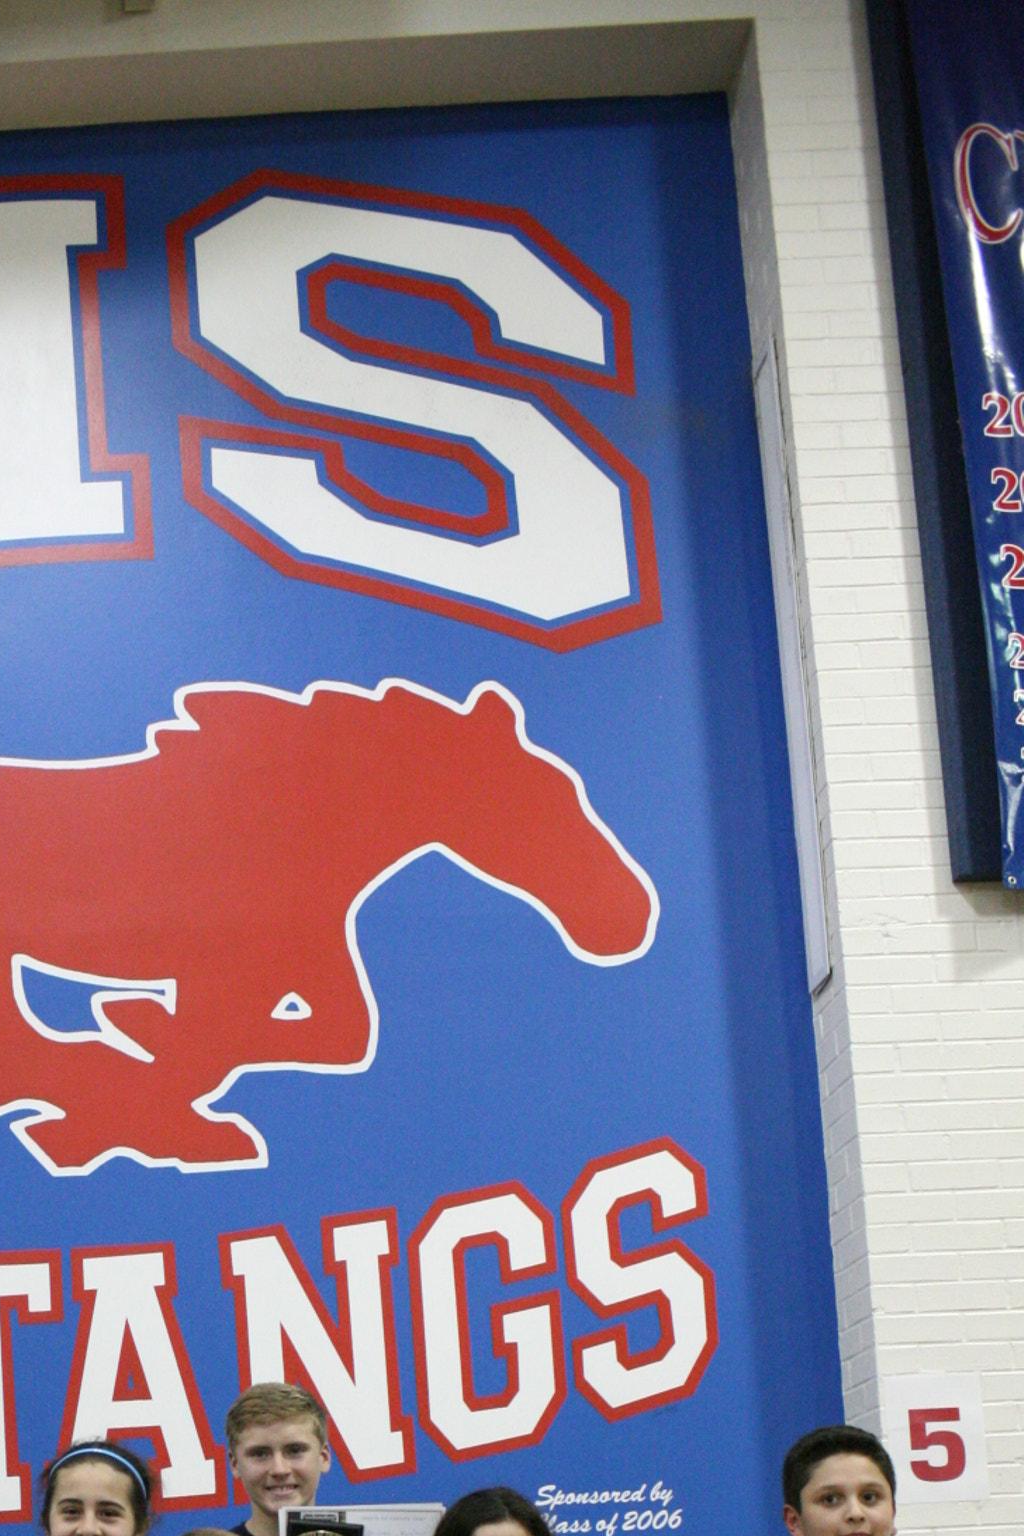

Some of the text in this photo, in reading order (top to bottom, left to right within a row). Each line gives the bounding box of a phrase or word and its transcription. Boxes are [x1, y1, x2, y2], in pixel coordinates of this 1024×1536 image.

[954, 123, 1024, 244] C
[991, 467, 1024, 513] 2
[907, 1407, 966, 1482] 5
[535, 1480, 674, 1511] Sponsored by
[540, 1512, 592, 1534] lass
[621, 1508, 683, 1531] 2006
